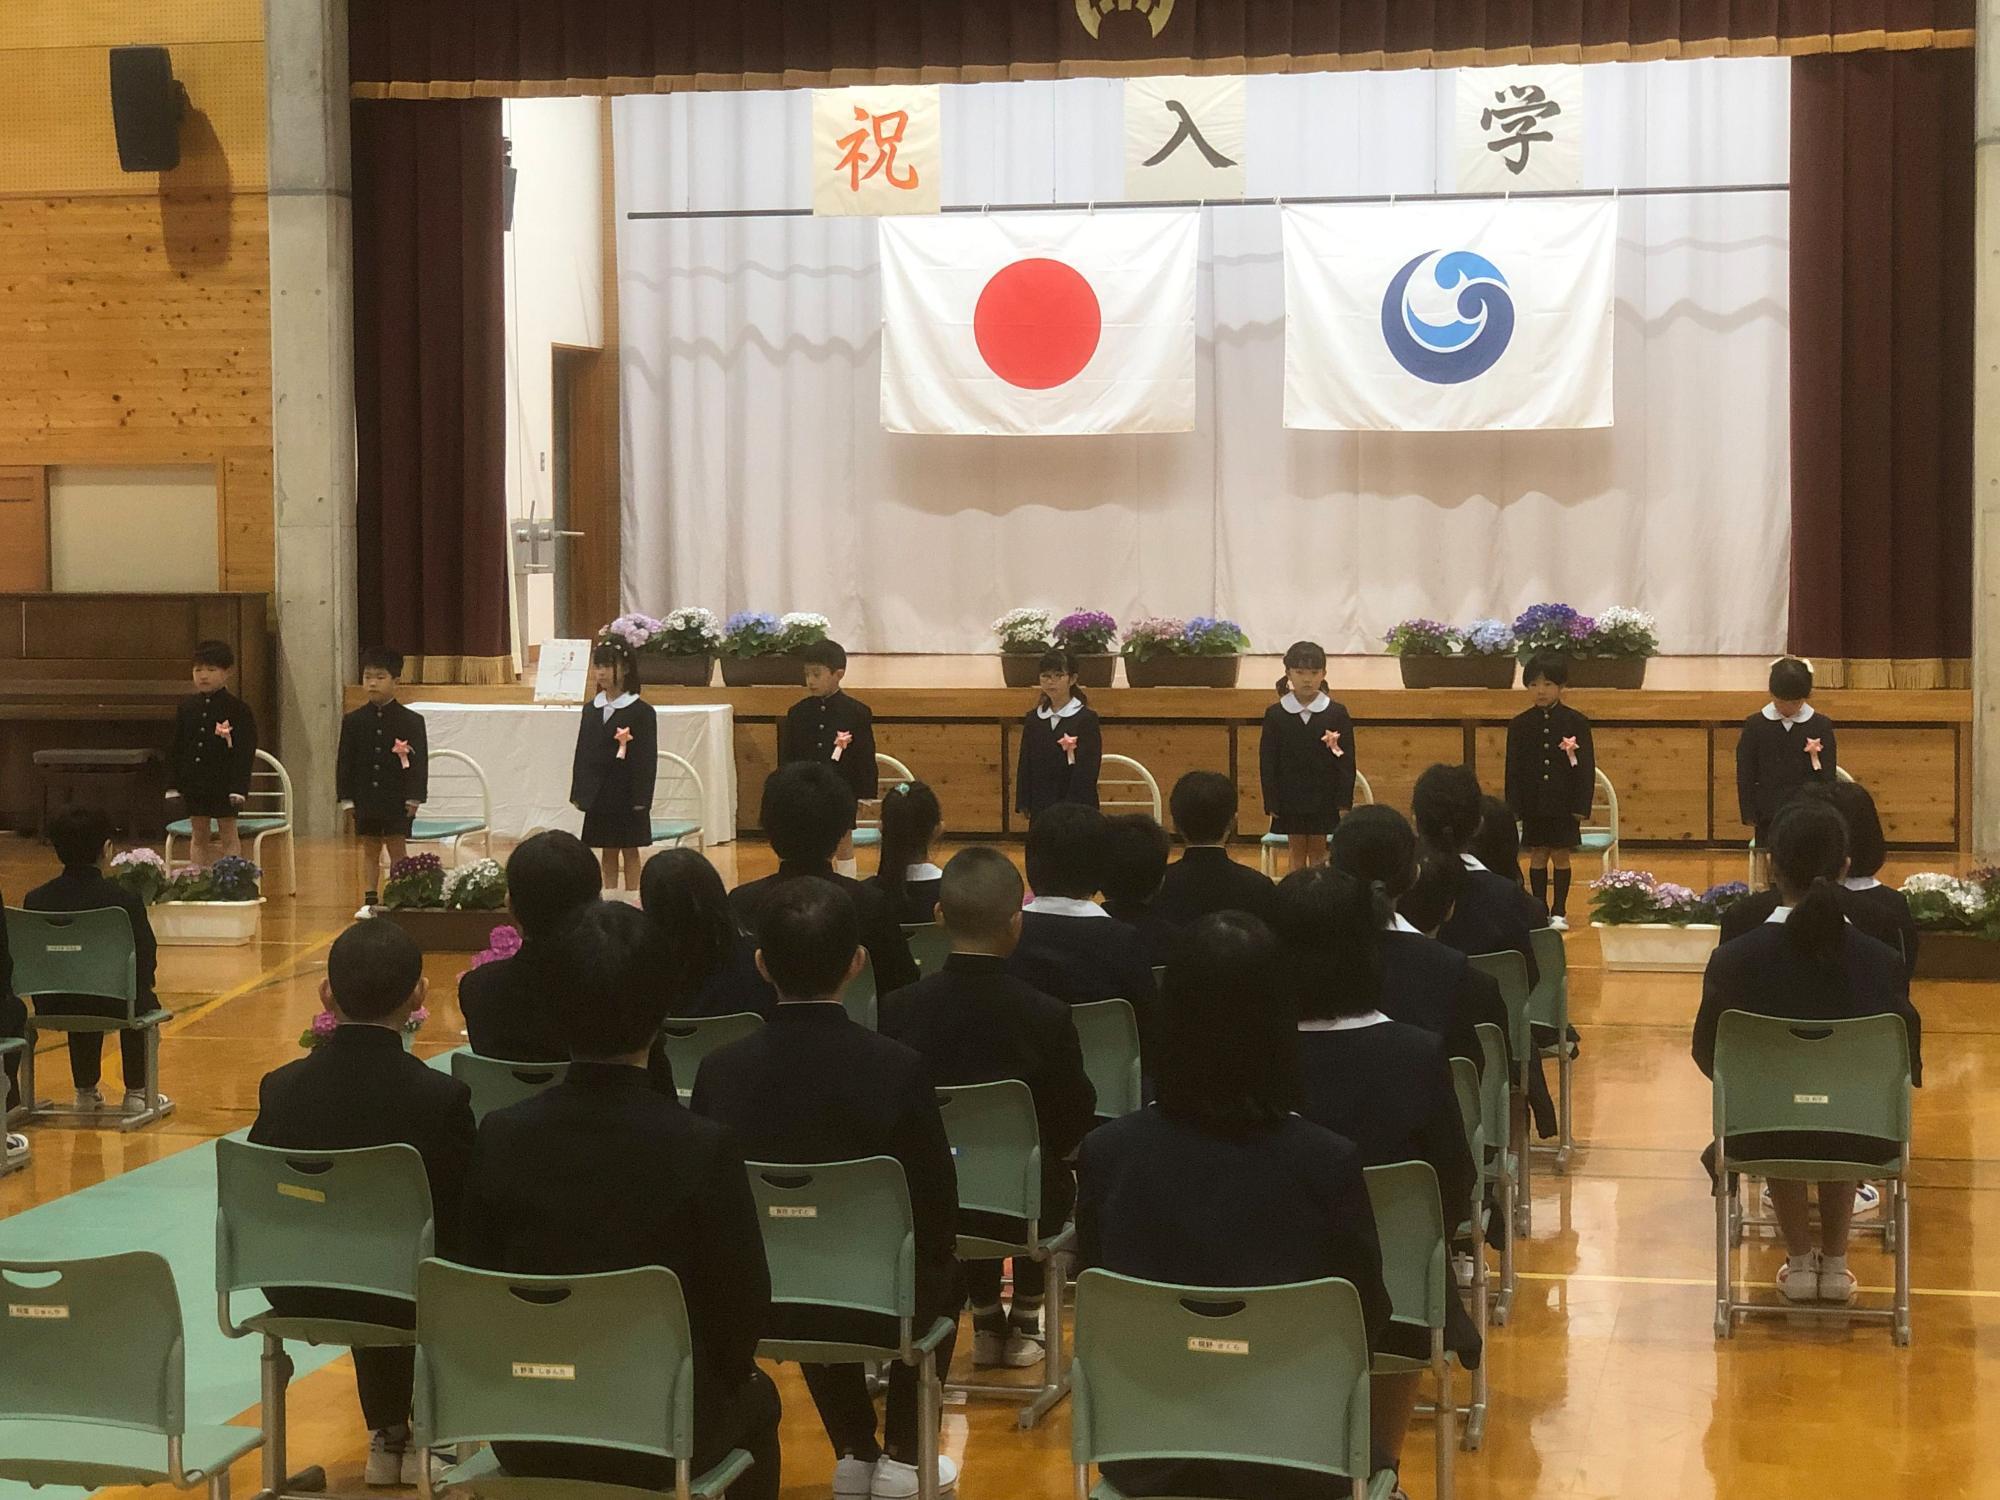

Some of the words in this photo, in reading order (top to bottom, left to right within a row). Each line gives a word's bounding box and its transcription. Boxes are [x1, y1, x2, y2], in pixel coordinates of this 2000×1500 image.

[834, 106, 919, 192] 祝
[1143, 99, 1238, 170] 入
[1480, 84, 1562, 175] 学
